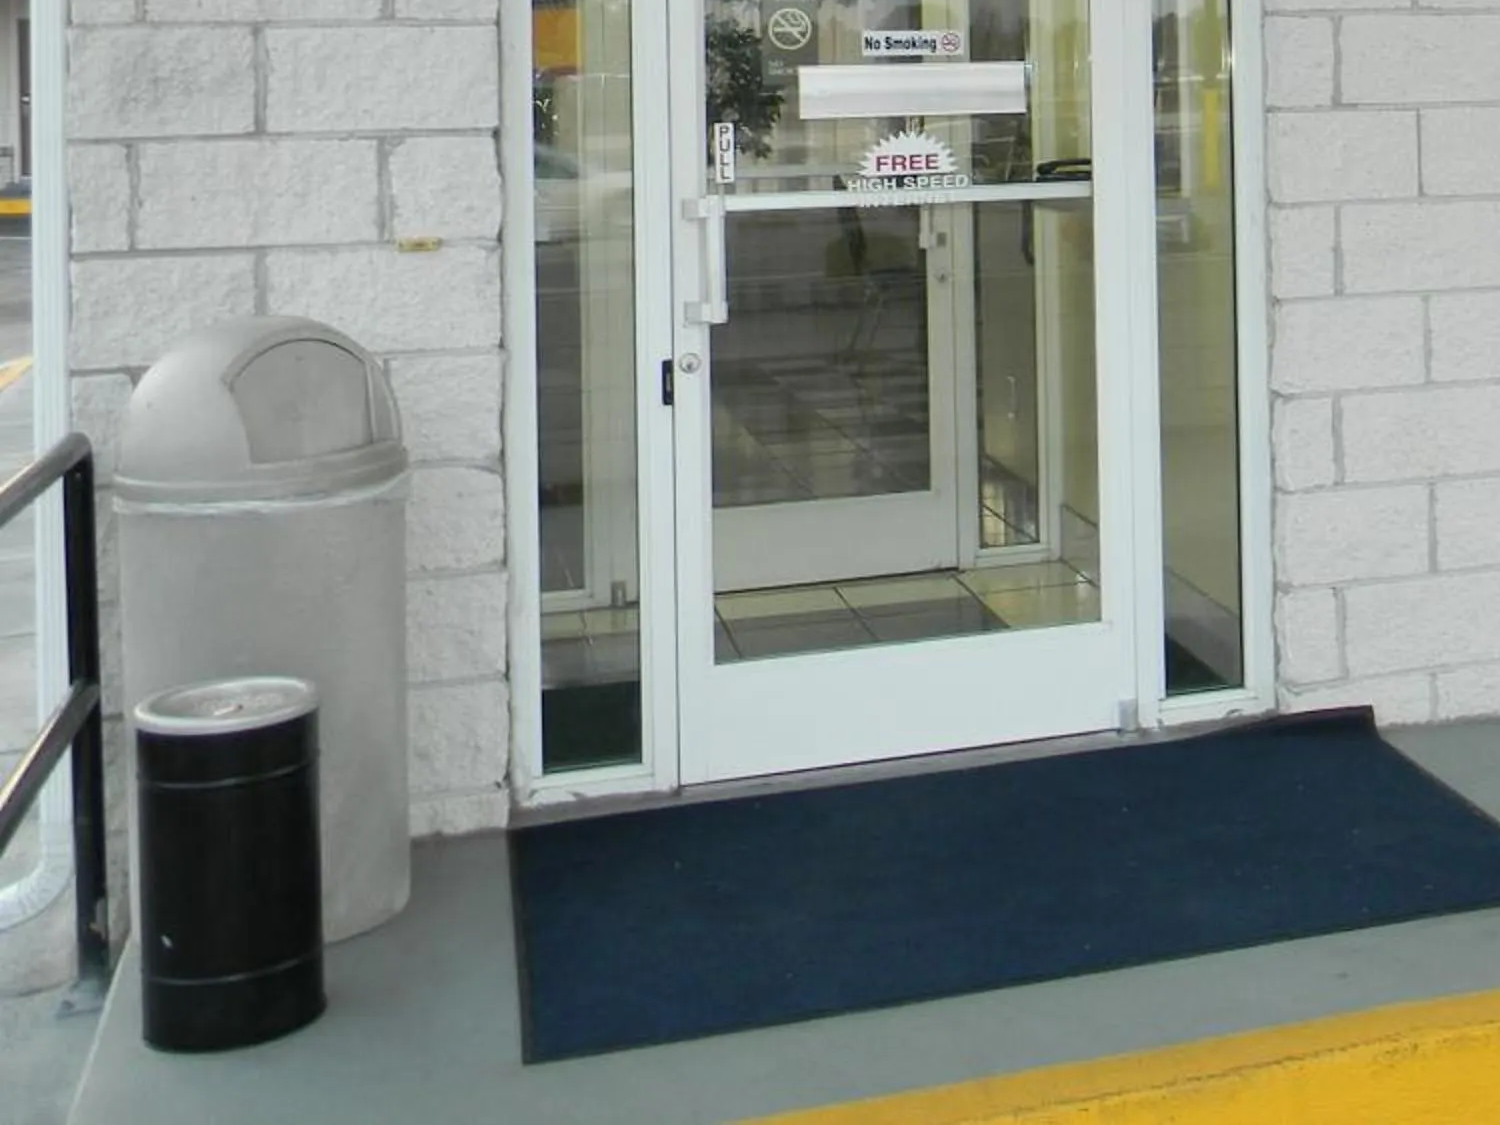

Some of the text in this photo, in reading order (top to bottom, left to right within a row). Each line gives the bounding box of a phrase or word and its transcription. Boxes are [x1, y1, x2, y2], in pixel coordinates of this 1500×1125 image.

[864, 36, 937, 53] No Smoking
[719, 125, 732, 180] PULL
[875, 154, 939, 172] FREE
[847, 174, 969, 192] HIGH SPEED
